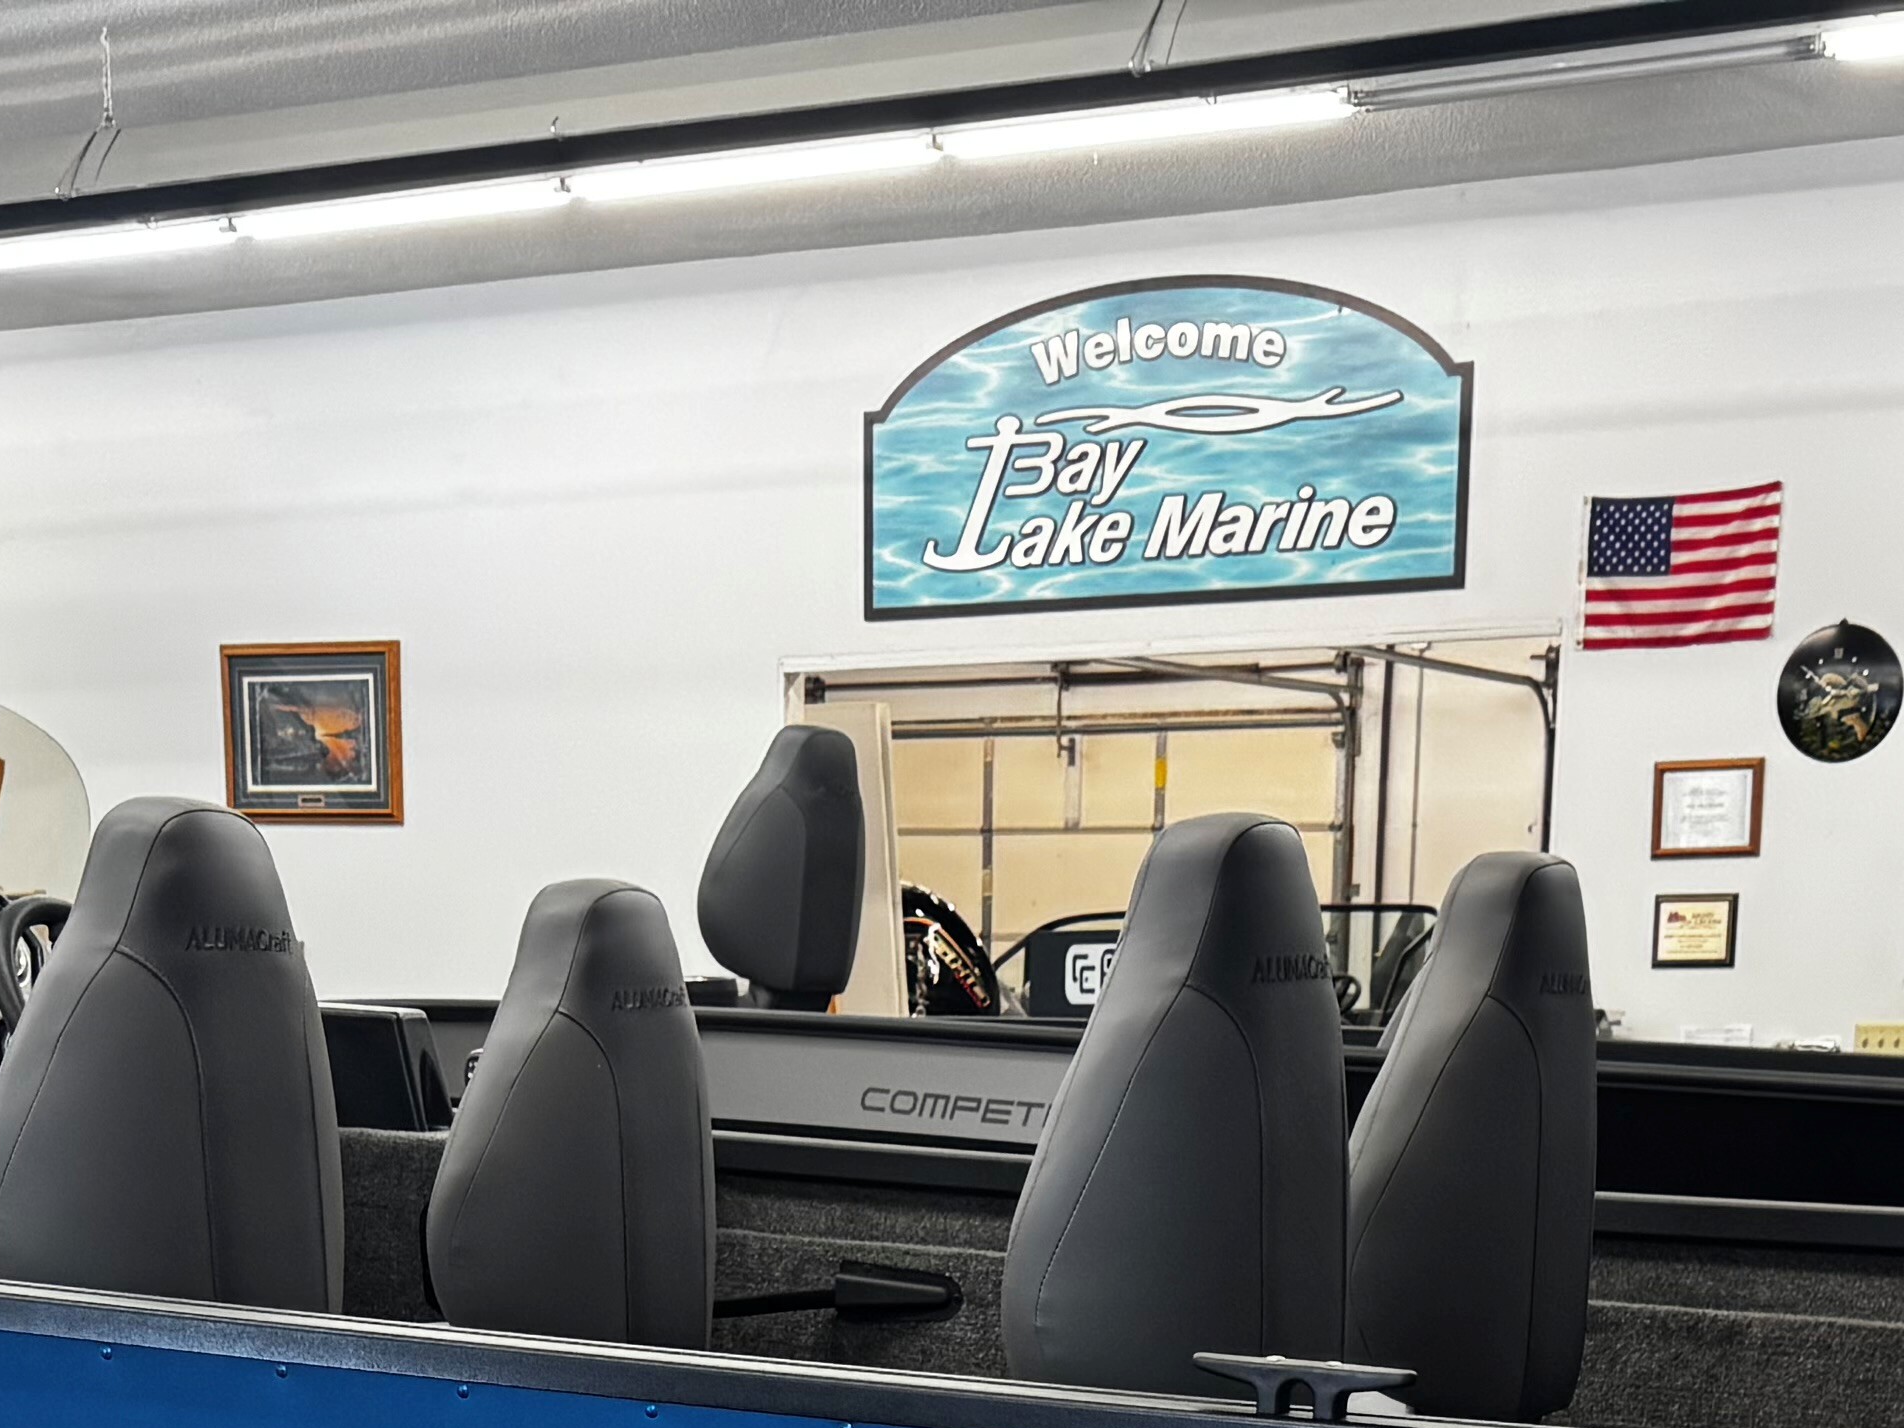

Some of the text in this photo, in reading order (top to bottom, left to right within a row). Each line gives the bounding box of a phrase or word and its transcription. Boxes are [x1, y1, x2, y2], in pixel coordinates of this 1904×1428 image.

[1029, 317, 1288, 386] Welcome
[965, 416, 1148, 505] Bay
[923, 465, 1397, 571] Lake Marine
